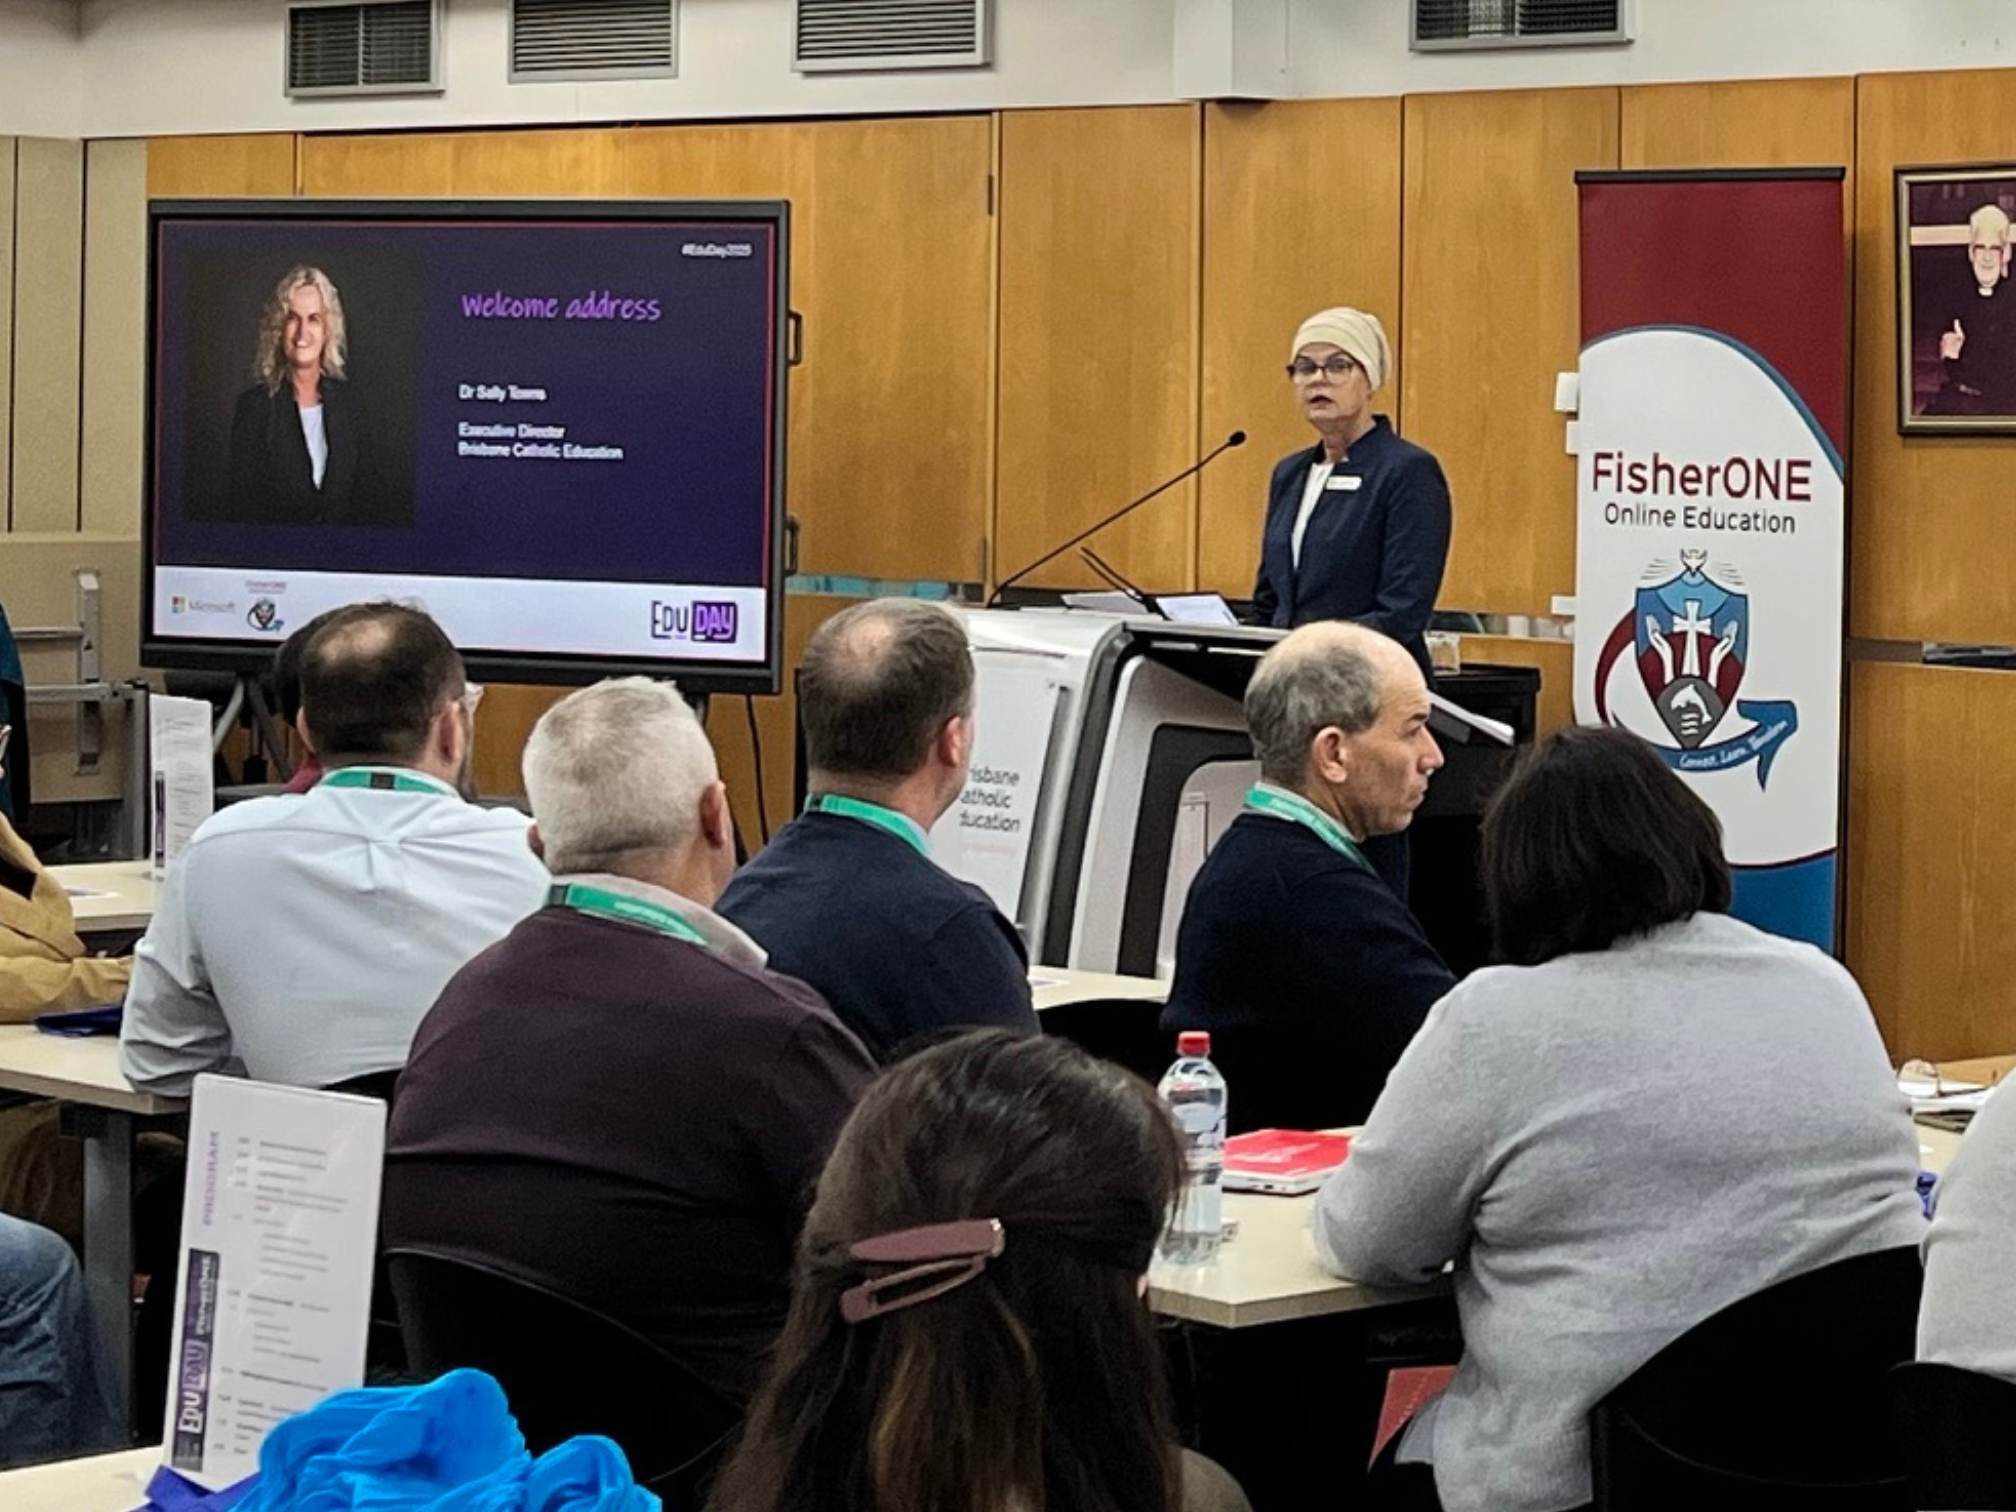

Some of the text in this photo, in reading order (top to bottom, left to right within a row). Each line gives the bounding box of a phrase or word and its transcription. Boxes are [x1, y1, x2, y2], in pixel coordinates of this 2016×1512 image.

[461, 290, 661, 320] Welcome address
[459, 384, 475, 399] Dr
[477, 385, 506, 402] Sally
[458, 422, 566, 438] Executive Director
[458, 441, 624, 459] Brisbane Catholic Education
[1593, 451, 1812, 502] FisherONE
[1605, 502, 1796, 533] Online Education
[961, 789, 1012, 809] atholic
